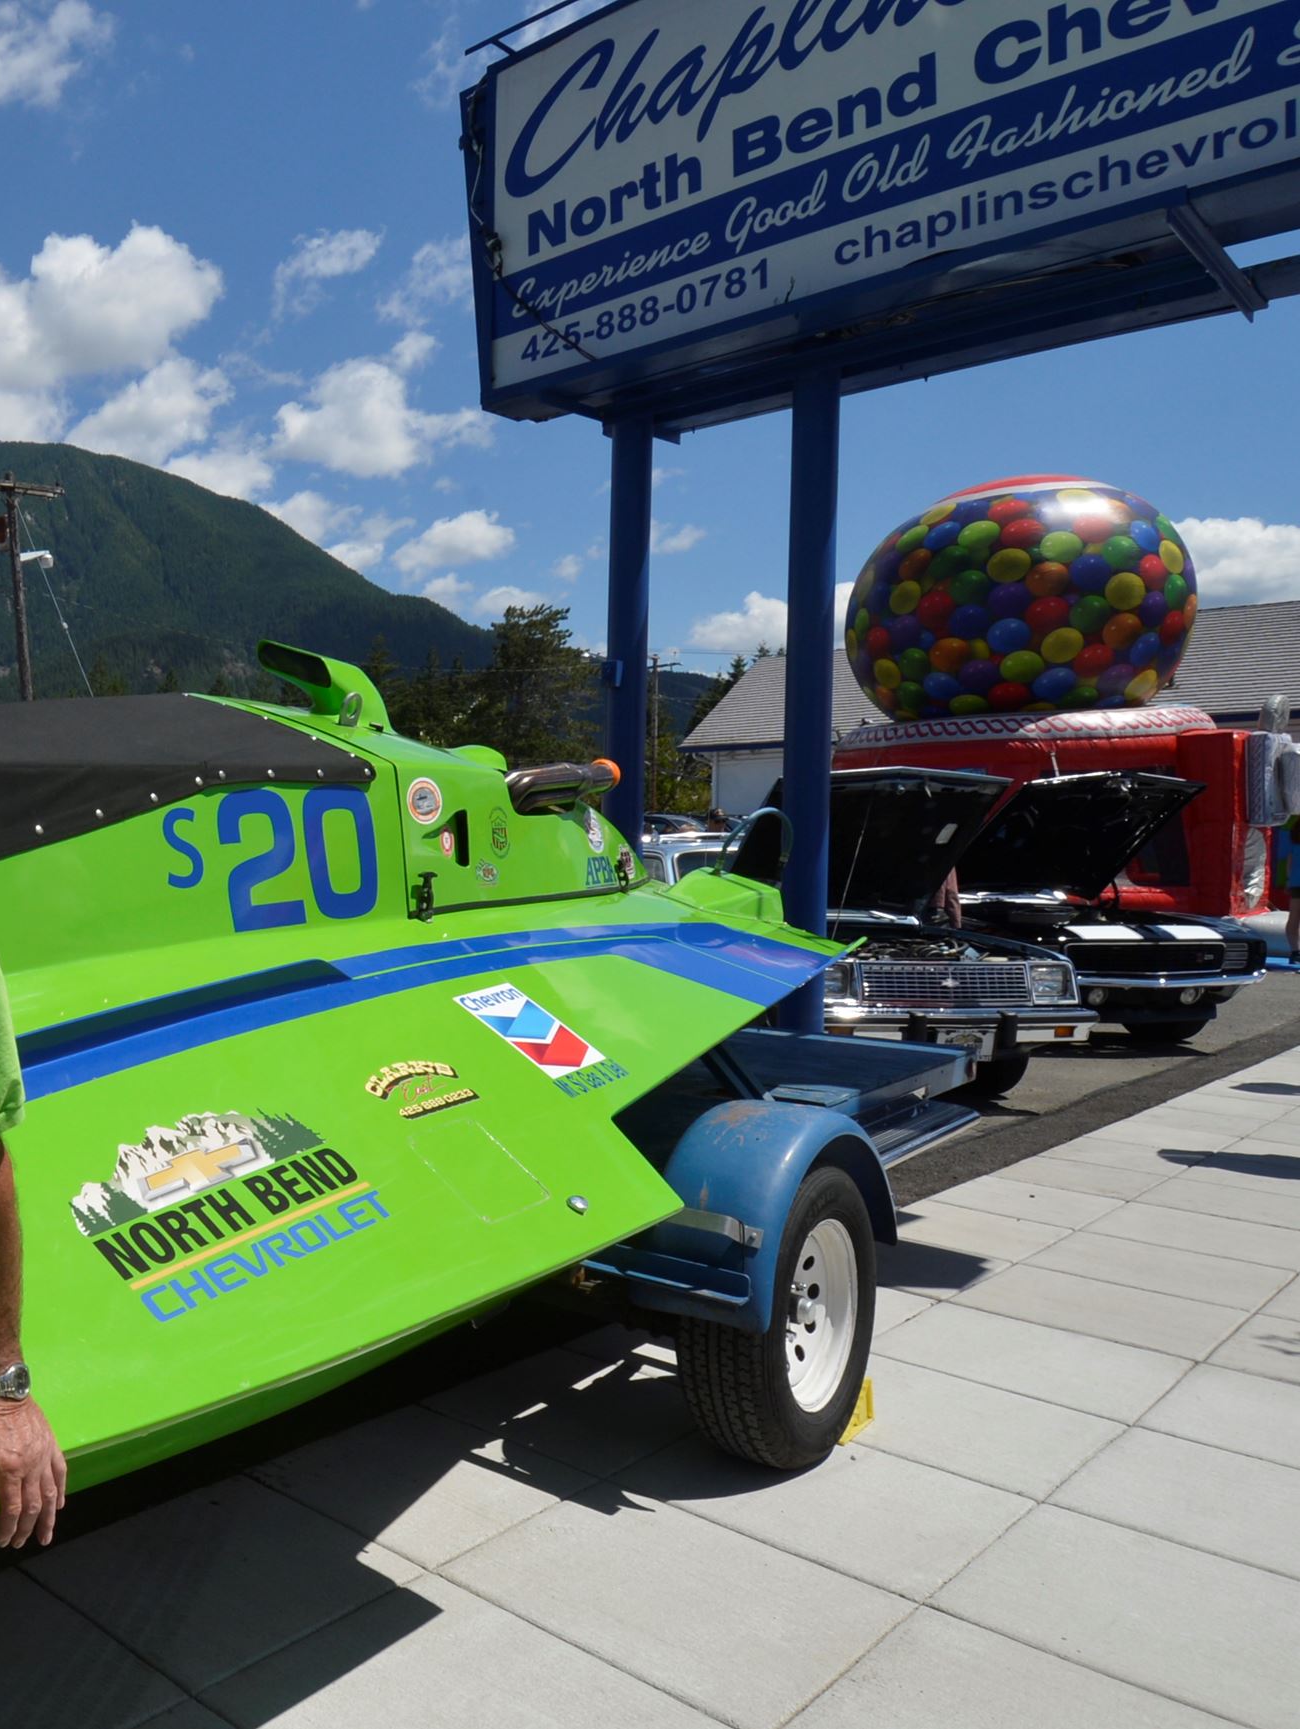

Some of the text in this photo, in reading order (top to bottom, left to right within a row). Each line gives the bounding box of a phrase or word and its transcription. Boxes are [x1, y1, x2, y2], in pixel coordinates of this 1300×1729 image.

[511, 231, 712, 319] Experience
[724, 168, 828, 254] Good
[842, 133, 930, 203] Old
[946, 26, 1254, 170] Fashioned
[528, 152, 702, 257] North
[732, 51, 938, 178] Bend
[520, 257, 769, 363] 425-888-0781
[458, 986, 523, 1012] Chevron
[92, 1147, 359, 1281] NORTH BEND
[140, 1189, 391, 1323] CHEVROLET
